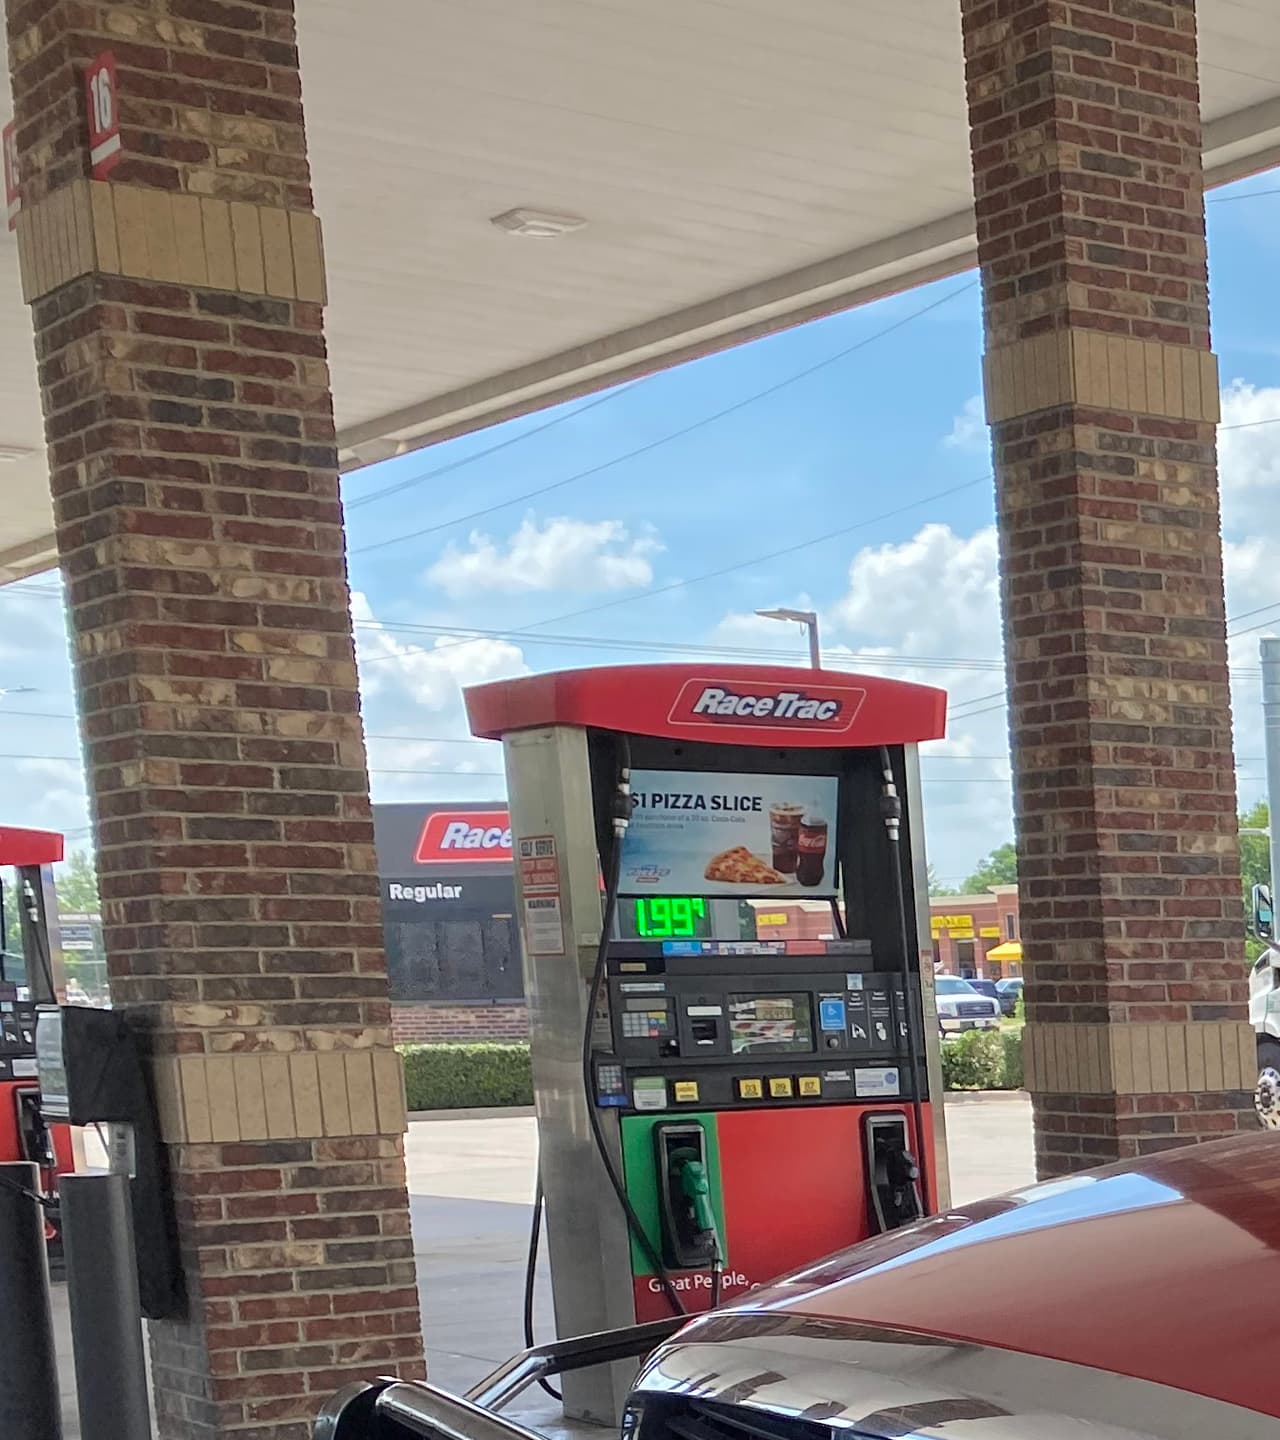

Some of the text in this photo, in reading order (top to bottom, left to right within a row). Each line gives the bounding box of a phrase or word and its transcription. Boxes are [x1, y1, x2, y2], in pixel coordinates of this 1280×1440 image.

[91, 67, 111, 133] 16
[693, 688, 836, 720] RaceTrac
[651, 793, 706, 810] PIZZA
[711, 795, 762, 811] SLICE
[389, 883, 462, 903] Regular
[694, 1271, 749, 1290] Peple,
